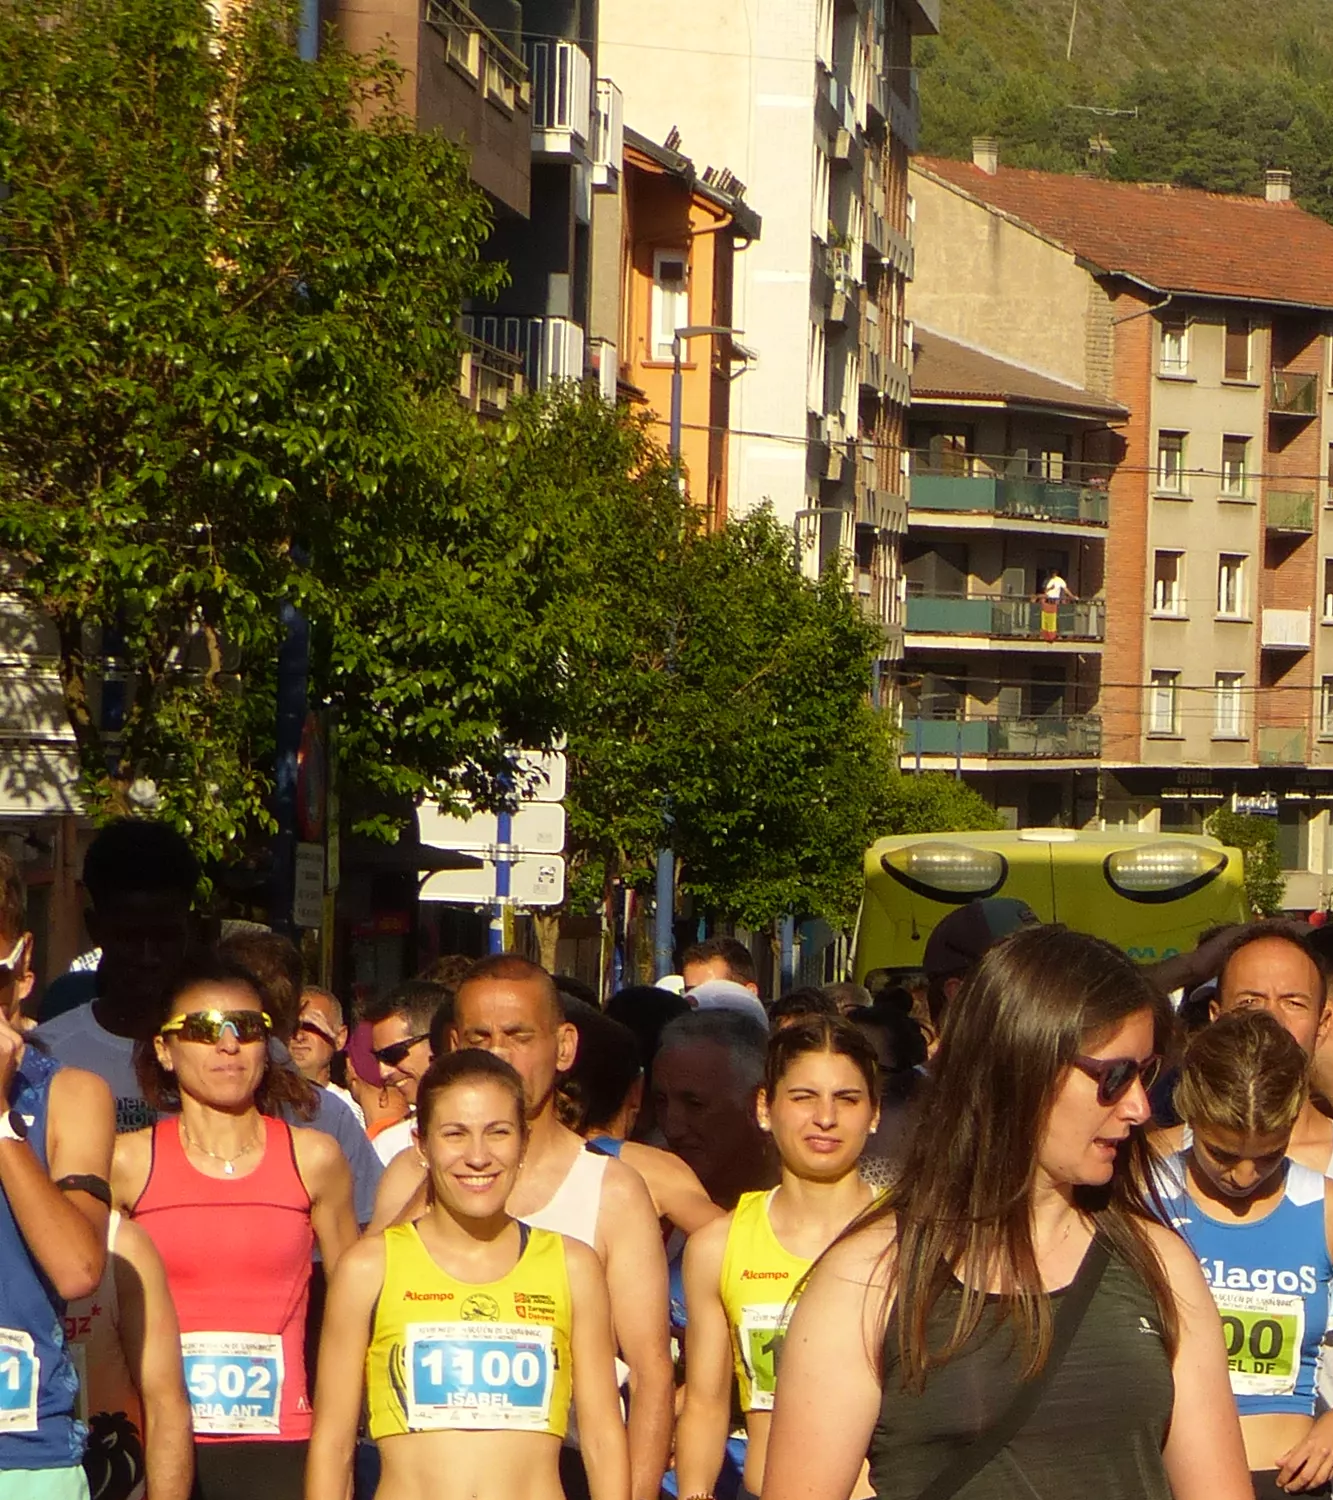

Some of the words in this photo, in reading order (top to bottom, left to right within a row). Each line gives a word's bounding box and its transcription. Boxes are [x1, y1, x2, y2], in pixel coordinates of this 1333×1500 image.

[741, 1269, 789, 1282] Alcampo
[403, 1291, 454, 1303] Alcampo
[421, 1348, 541, 1388] 1100
[1253, 1361, 1276, 1375] DF
[188, 1363, 271, 1400] 502
[446, 1391, 512, 1407] ISABEL
[229, 1404, 263, 1417] ANT
